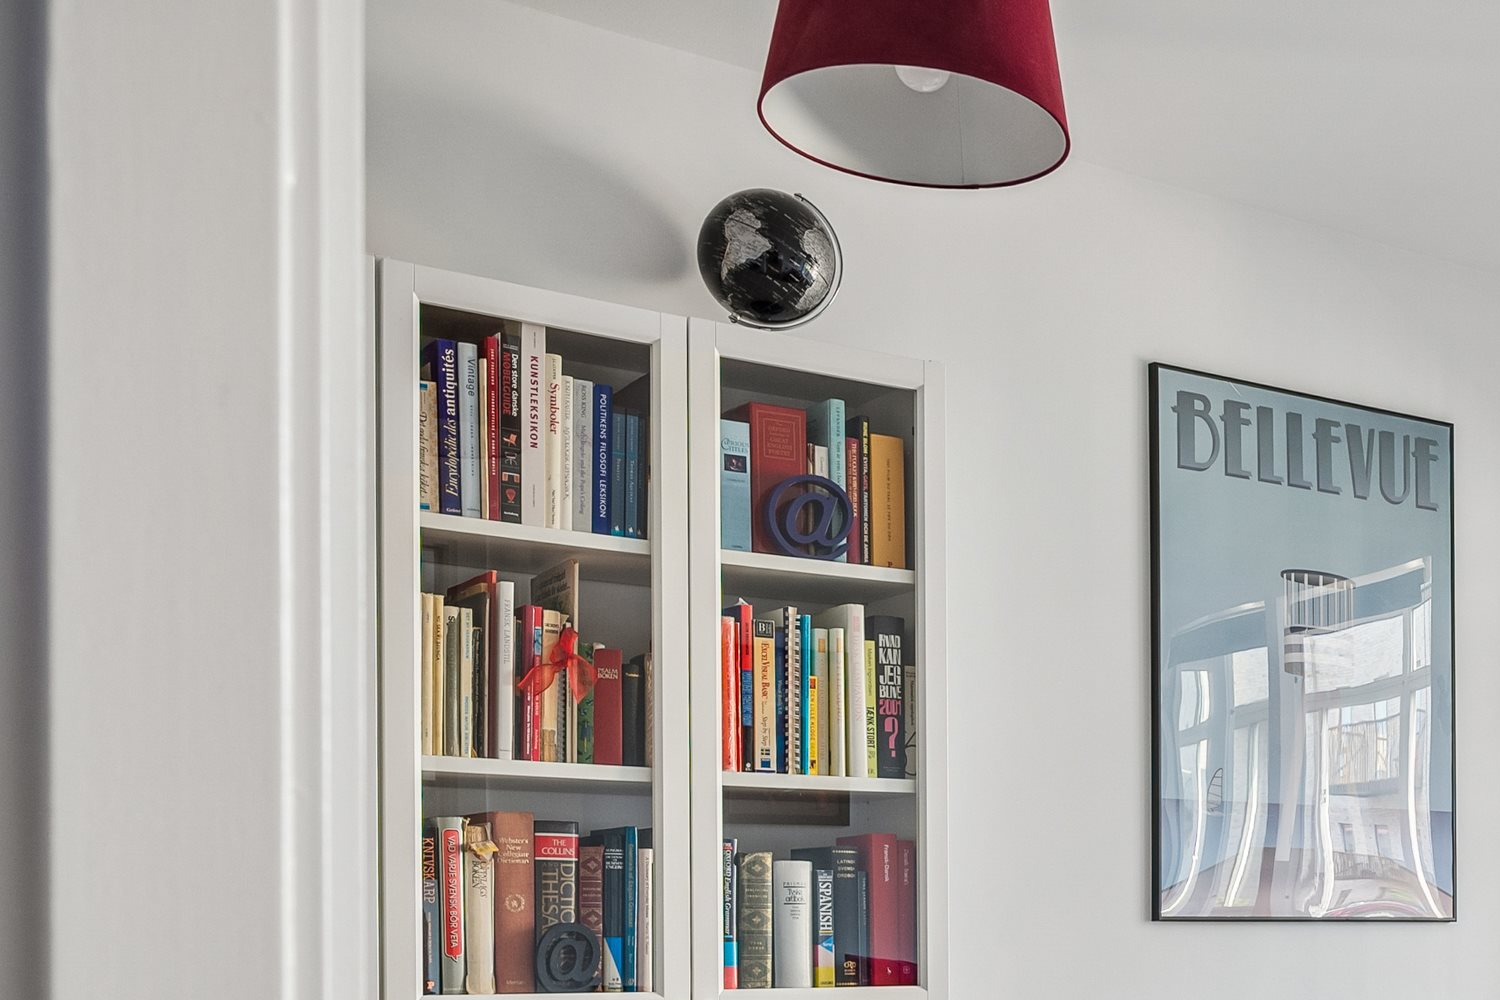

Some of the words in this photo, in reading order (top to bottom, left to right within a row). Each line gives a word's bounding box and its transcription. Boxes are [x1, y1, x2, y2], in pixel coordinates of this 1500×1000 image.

[511, 353, 519, 369] Den
[441, 349, 456, 414] antiquités
[466, 358, 476, 396] Vintage
[502, 352, 511, 415] MØBELGUIDE
[511, 370, 519, 388] store
[511, 390, 519, 417] danske
[529, 355, 539, 449] KUNSTLEKSIKON
[547, 382, 560, 434] Symboler
[444, 418, 457, 434] des
[598, 394, 607, 439] POLITIKENS
[598, 442, 607, 476] FILOSOFI
[1171, 390, 1440, 512] BELLEVUE
[444, 434, 460, 496] Encyclopédie
[598, 479, 607, 518] LEKSIKON
[503, 600, 511, 627] FRANSK
[503, 629, 511, 664] LANDSTIL
[878, 634, 901, 648] HVAD
[878, 648, 901, 664] KAN
[597, 673, 618, 681] BOKEN
[879, 665, 901, 685] JEG
[879, 685, 902, 699] BLIVE
[867, 706, 875, 725] TÆNK
[879, 699, 901, 715] 2001
[867, 727, 875, 748] STORT
[447, 835, 457, 852] VAD
[541, 846, 575, 855] COLLINS
[422, 837, 436, 904] KNIVSKARP
[448, 854, 458, 877] VARJE
[724, 850, 732, 877] OXFORD
[448, 878, 458, 909] SVENSK
[724, 877, 732, 902] English
[449, 910, 460, 928] BÖR
[724, 902, 732, 935] Grammar
[819, 882, 833, 931] SPANISH
[449, 930, 459, 948] VETA
